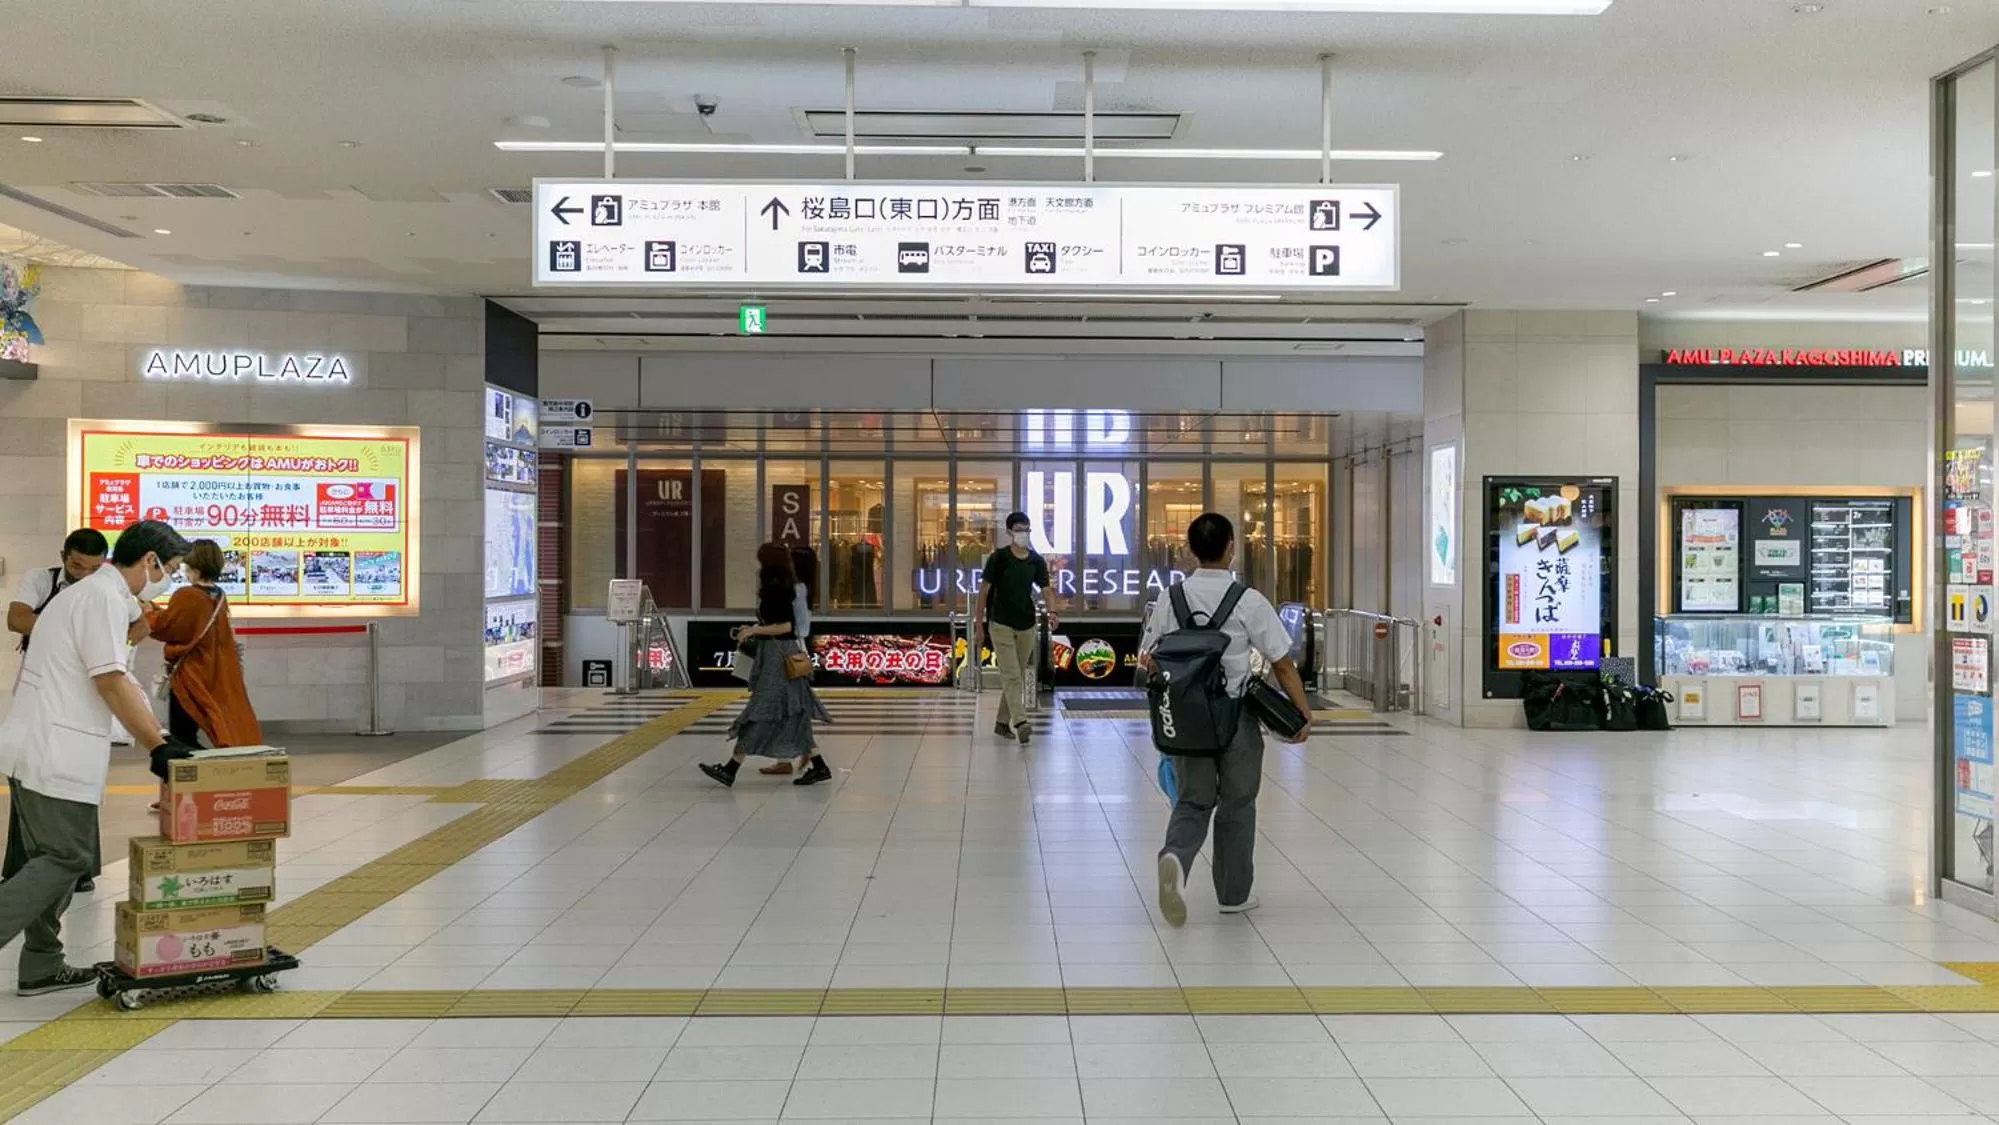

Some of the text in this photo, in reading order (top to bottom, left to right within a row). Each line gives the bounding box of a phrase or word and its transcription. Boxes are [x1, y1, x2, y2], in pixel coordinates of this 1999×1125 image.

[628, 199, 721, 212] アミュプラザ 本館
[801, 196, 1001, 221] 桜島口(東口)方面
[1181, 202, 1305, 215] アミュプラザ プレミアム館
[586, 243, 636, 255] エレベーター
[680, 244, 734, 256] コインロッカー
[833, 244, 857, 257] 市電
[933, 245, 1008, 257] バスターミナル
[1026, 243, 1055, 253] TAXI
[1060, 245, 1105, 257] タクシー
[1137, 245, 1211, 257] コインロッカー
[1315, 248, 1335, 273] P
[146, 352, 349, 380] AMUPLAZA
[1667, 349, 1711, 367] AMU
[1719, 349, 1778, 367] PLAZA
[1781, 349, 1900, 368] KAGOSHIMA
[136, 454, 265, 471] 車でのショッピングは
[657, 480, 683, 500] UR
[95, 503, 135, 515] サービス
[207, 503, 311, 528] 90分無料
[1027, 471, 1132, 556] UR
[233, 536, 348, 548] 200店舗以上が対象!!
[1535, 558, 1562, 624] きんつば
[825, 650, 945, 671] 土用の丑の日
[189, 941, 216, 958] もも
